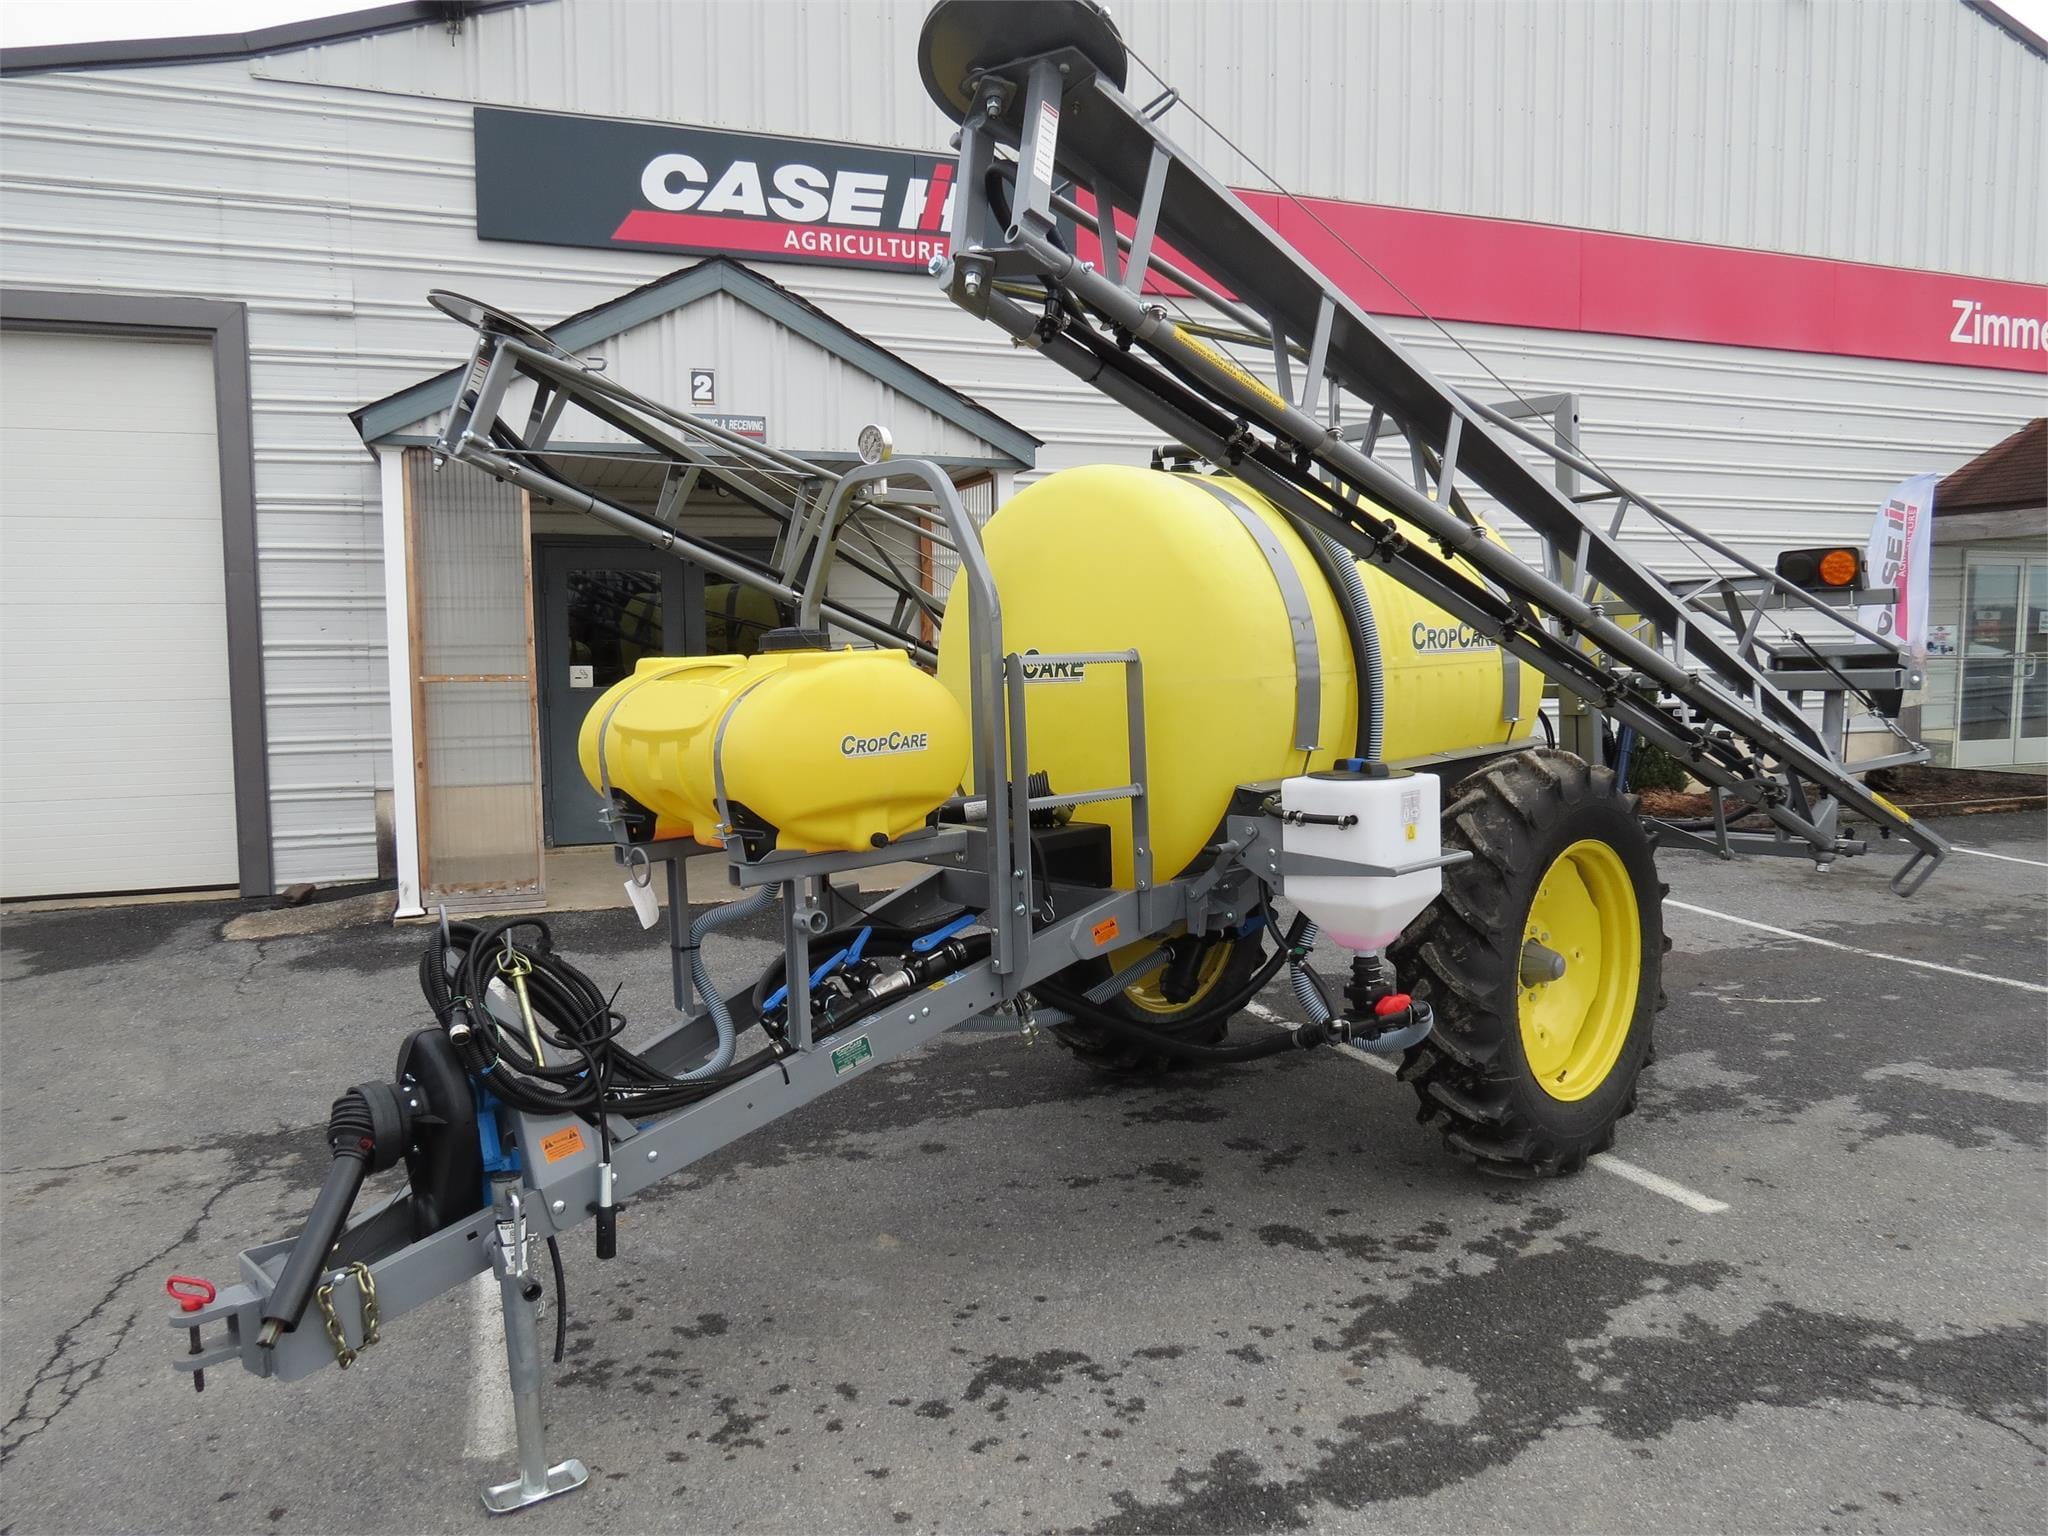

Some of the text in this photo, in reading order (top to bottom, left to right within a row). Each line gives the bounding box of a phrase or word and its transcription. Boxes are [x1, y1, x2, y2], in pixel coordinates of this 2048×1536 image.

[641, 153, 889, 227] CASE
[783, 229, 945, 260] AGRICULTURE
[693, 375, 713, 400] 2
[728, 419, 764, 431] RECEIVING
